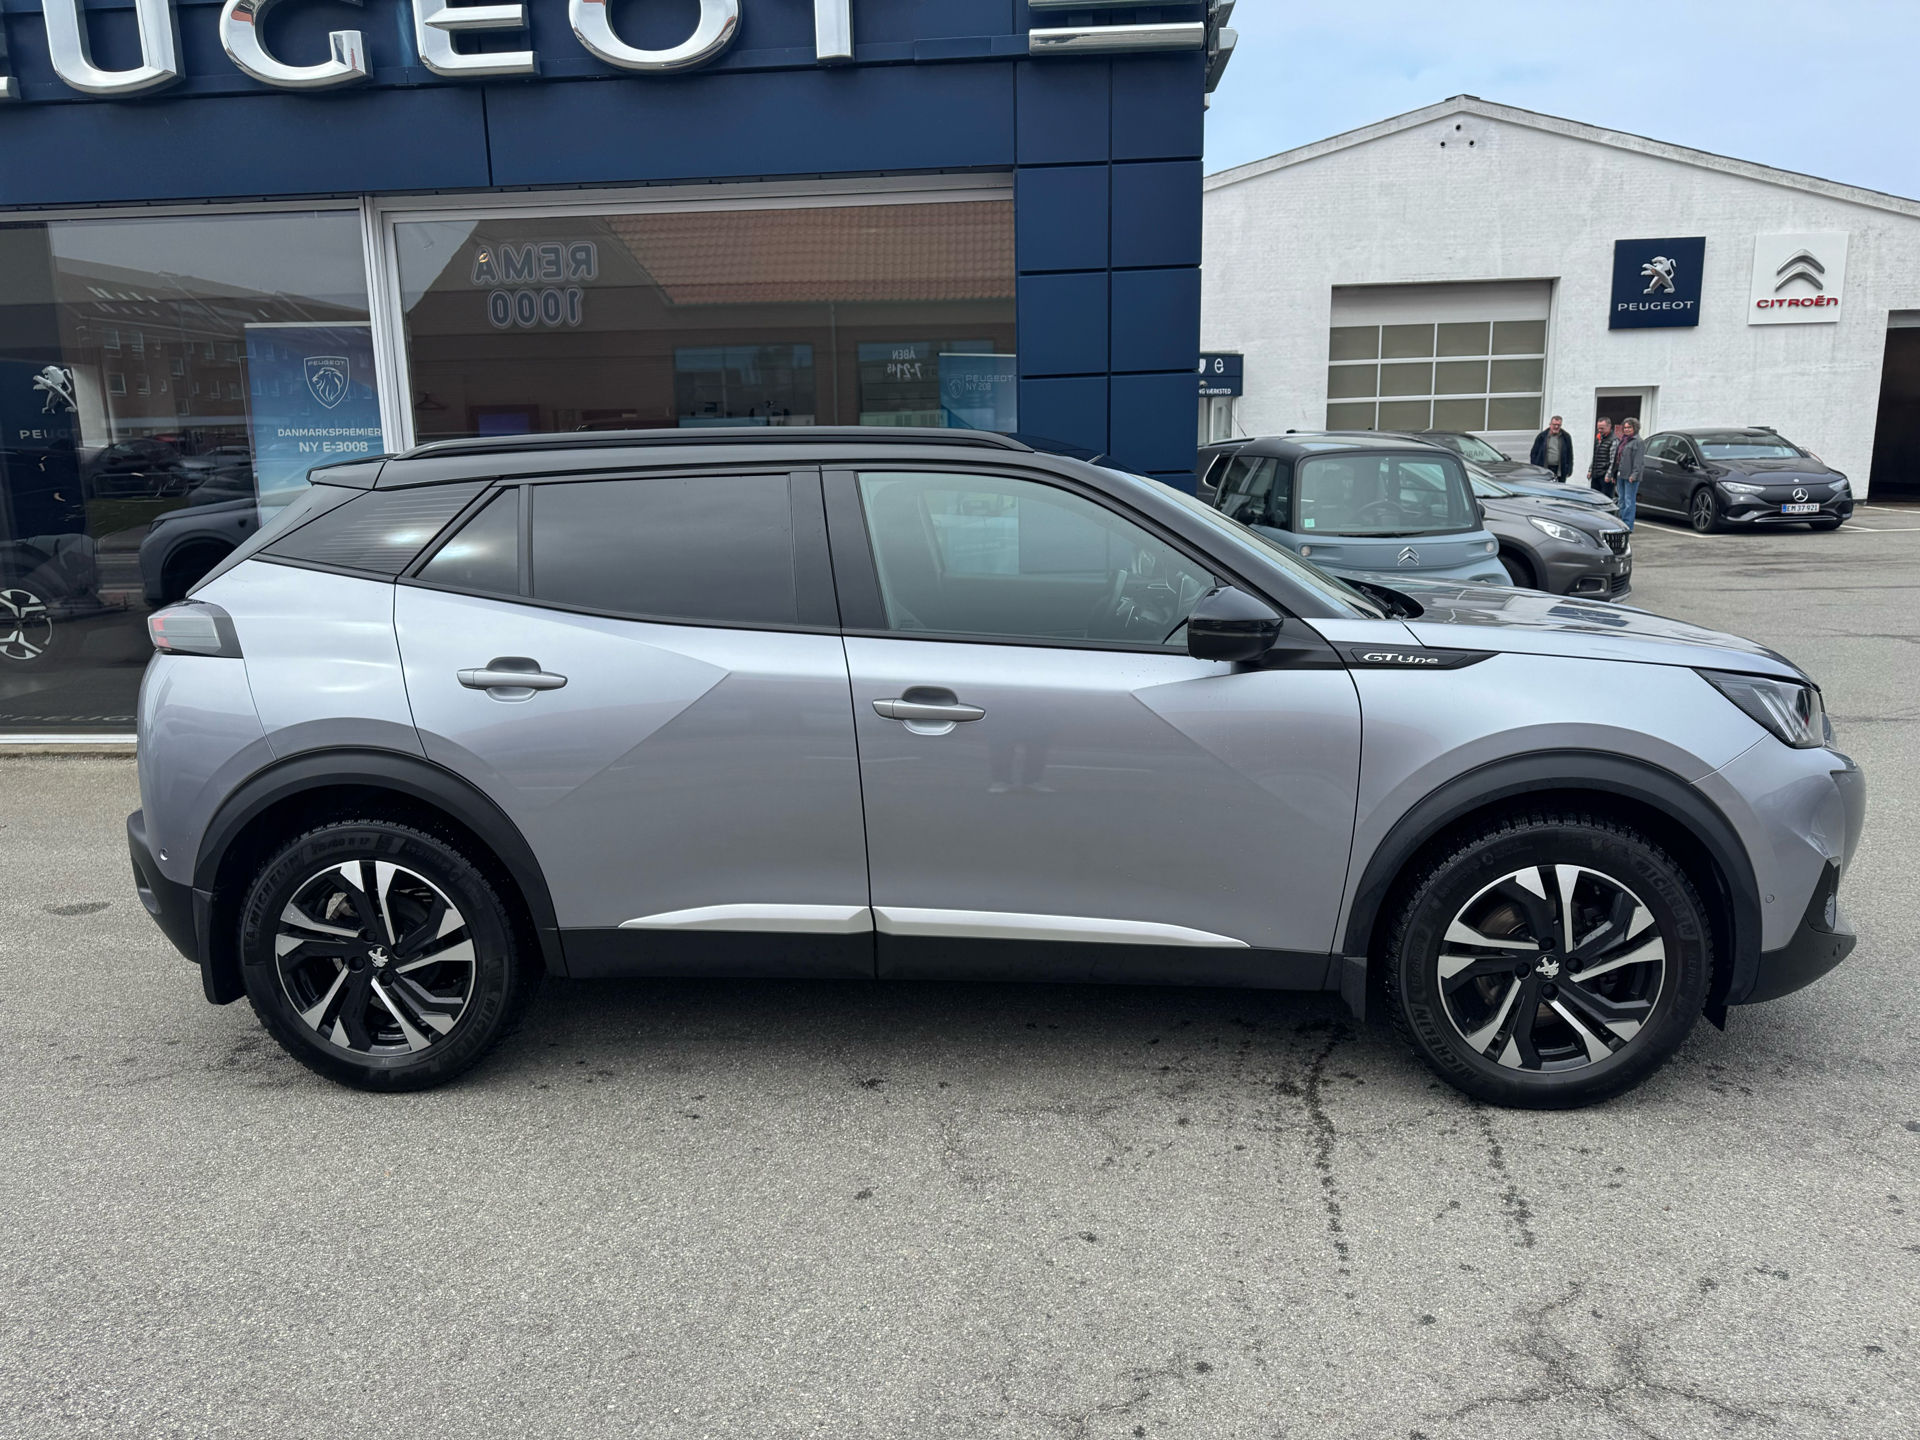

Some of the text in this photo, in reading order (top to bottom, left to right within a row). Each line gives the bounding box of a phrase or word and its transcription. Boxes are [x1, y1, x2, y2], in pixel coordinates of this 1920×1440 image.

[0, 0, 856, 97] UGEO
[1618, 301, 1694, 311] PEUGEOT
[965, 374, 1014, 382] PEUGEOT
[965, 382, 992, 391] NY 208
[299, 441, 369, 452] NY E-3008
[1362, 652, 1398, 662] GT
[1414, 1007, 1480, 1083] MICHELIN
